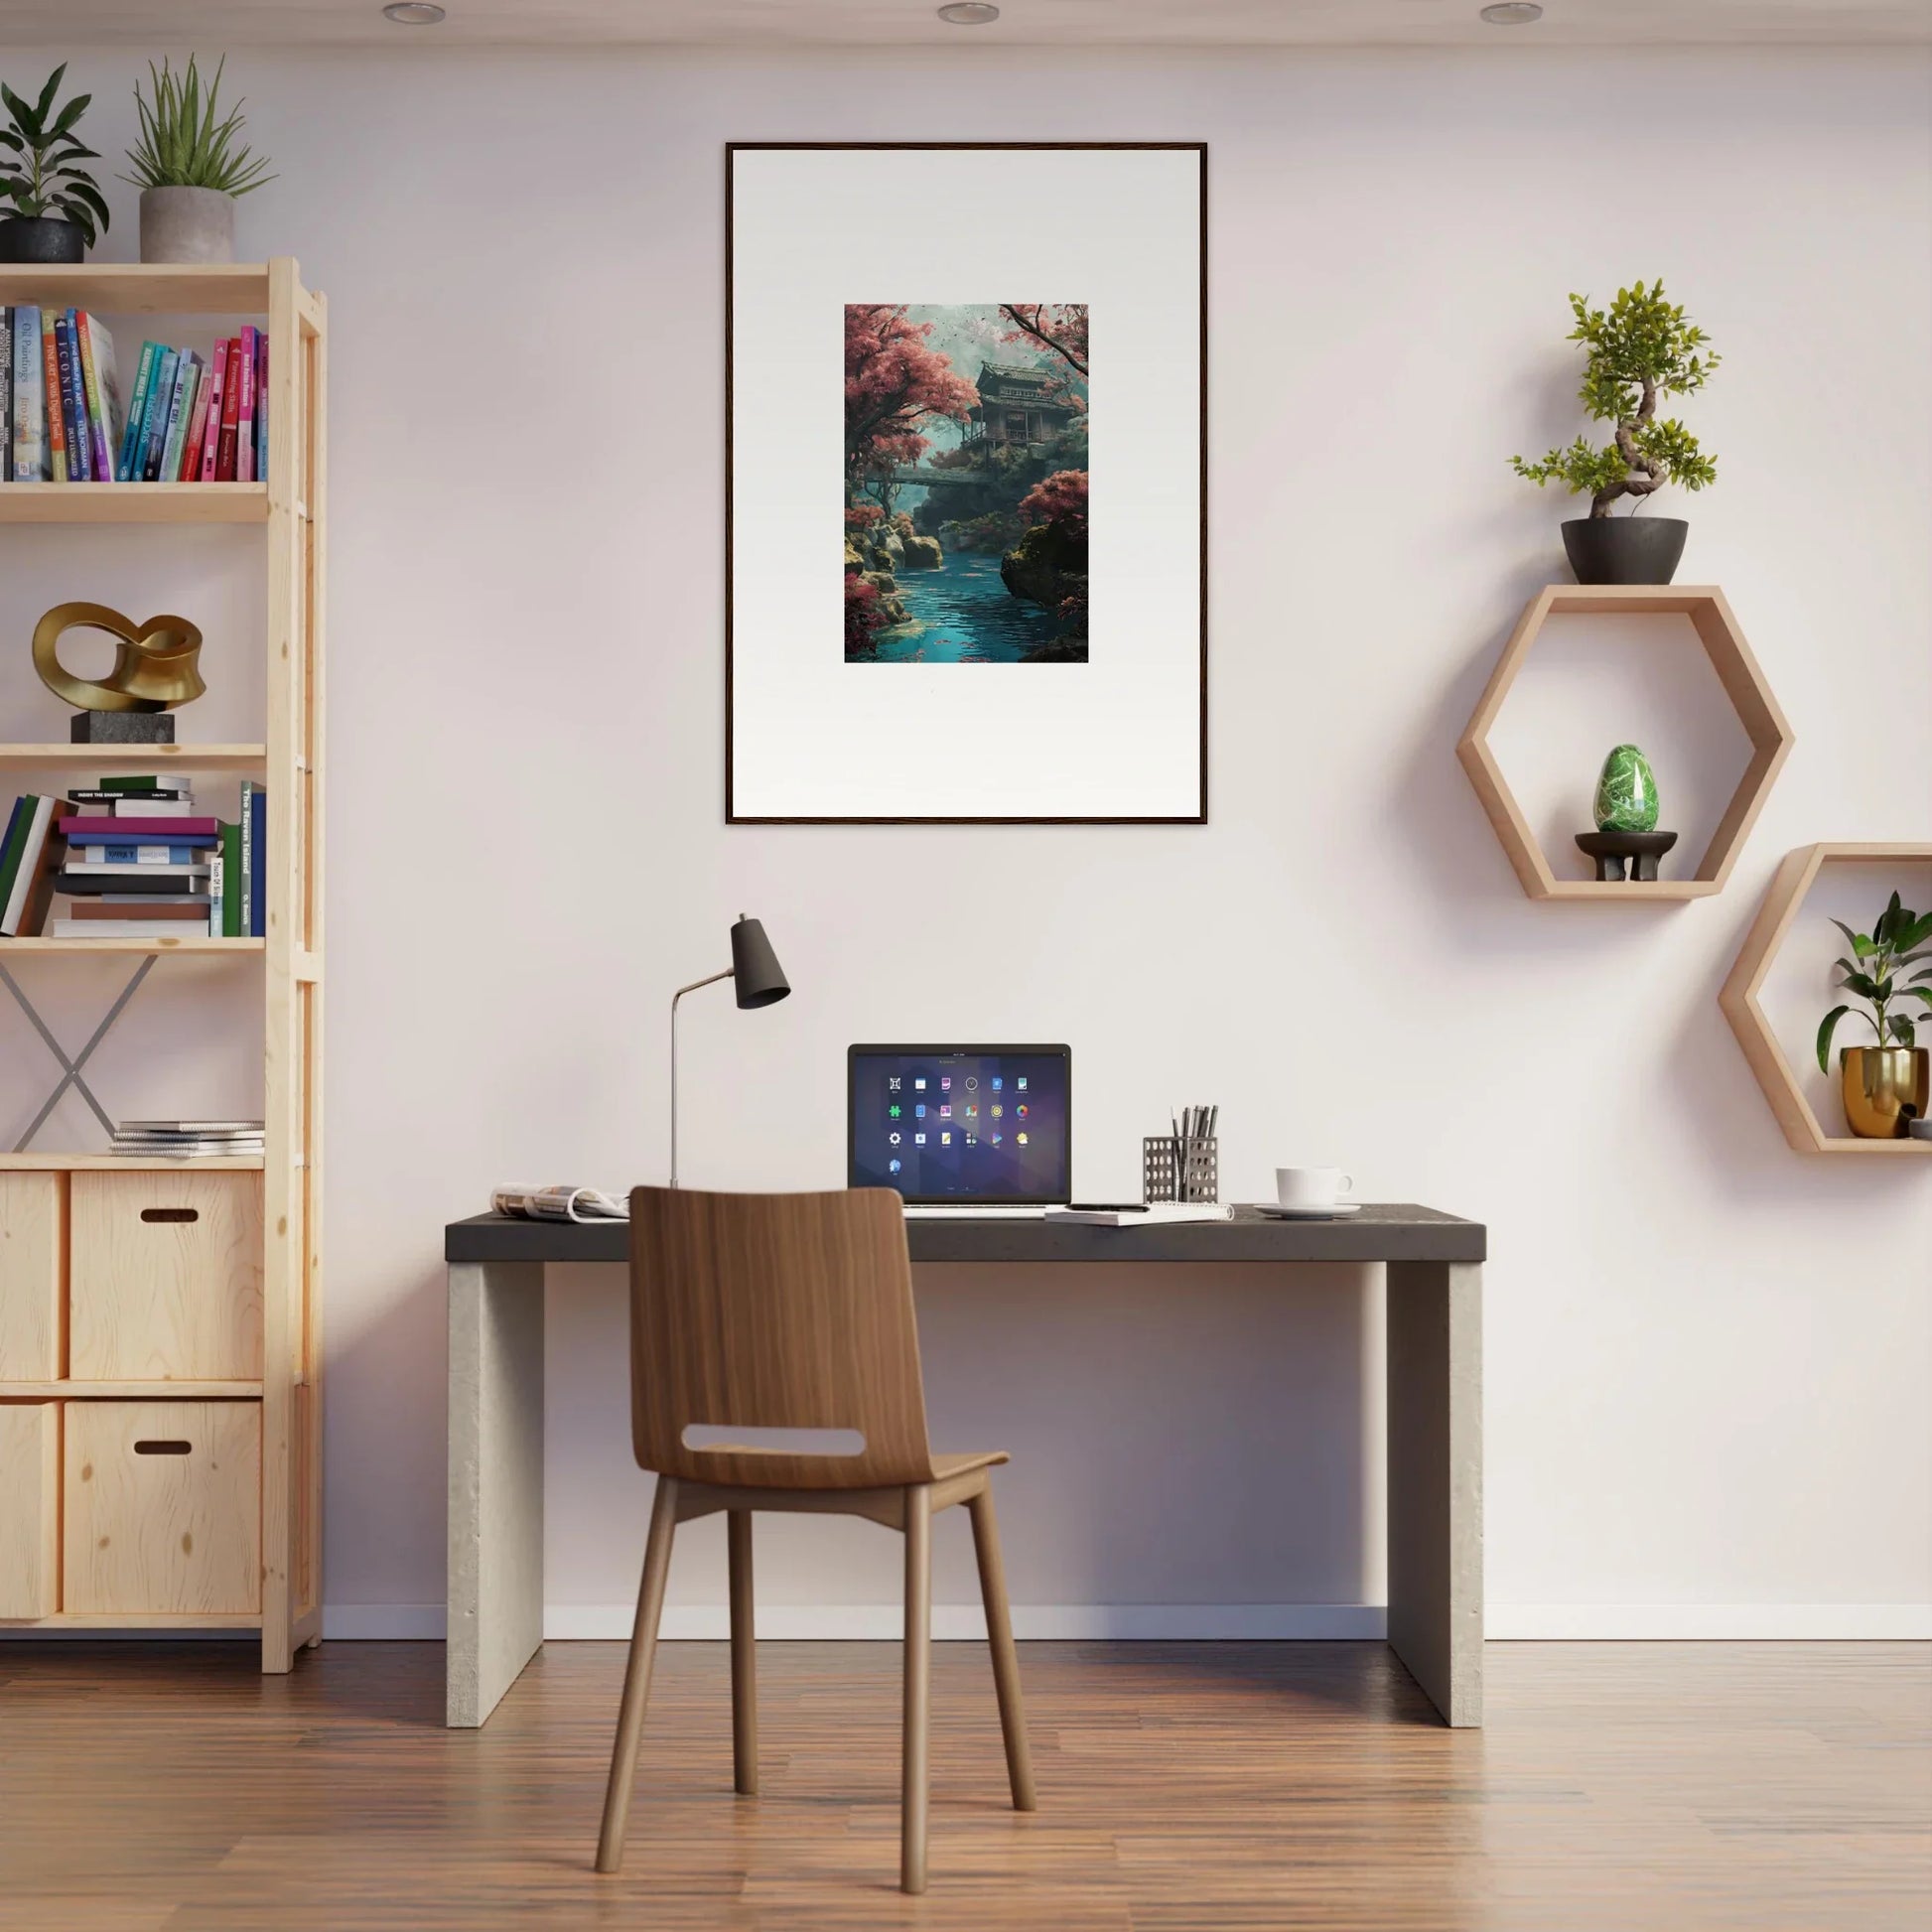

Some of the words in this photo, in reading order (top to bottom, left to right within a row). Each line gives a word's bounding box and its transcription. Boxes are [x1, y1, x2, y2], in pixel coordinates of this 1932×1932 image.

[22, 323, 33, 338] Oil
[19, 340, 33, 382] Paintings
[48, 361, 57, 375] ART
[79, 324, 91, 369] Watercolor
[86, 372, 97, 408] Portraits
[228, 360, 239, 391] Parenting
[49, 381, 58, 399] With
[49, 400, 60, 422] Digital
[141, 393, 156, 444] SUCCESSFUL
[78, 436, 88, 469] NORMAN
